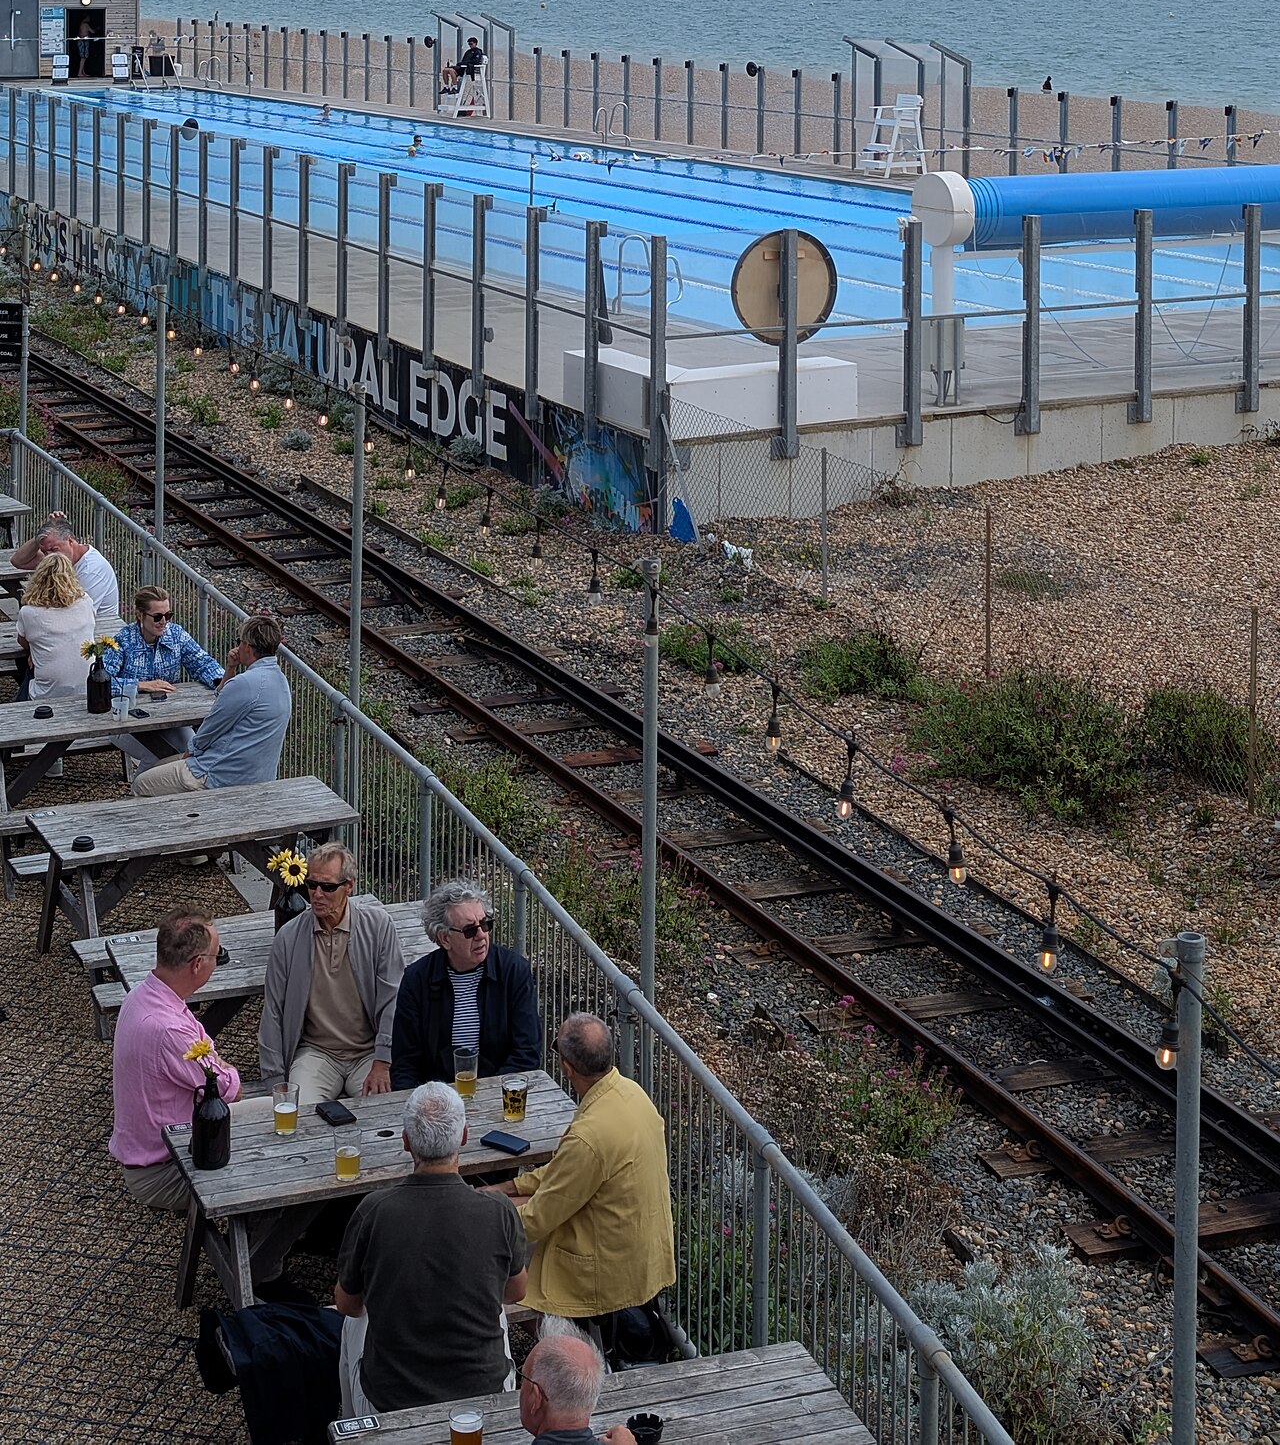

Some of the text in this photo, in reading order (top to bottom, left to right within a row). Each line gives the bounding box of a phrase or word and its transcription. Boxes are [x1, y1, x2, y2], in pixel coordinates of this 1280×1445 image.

[211, 276, 255, 344] THE
[263, 304, 399, 416] NATURAL
[409, 359, 508, 461] EDGE
